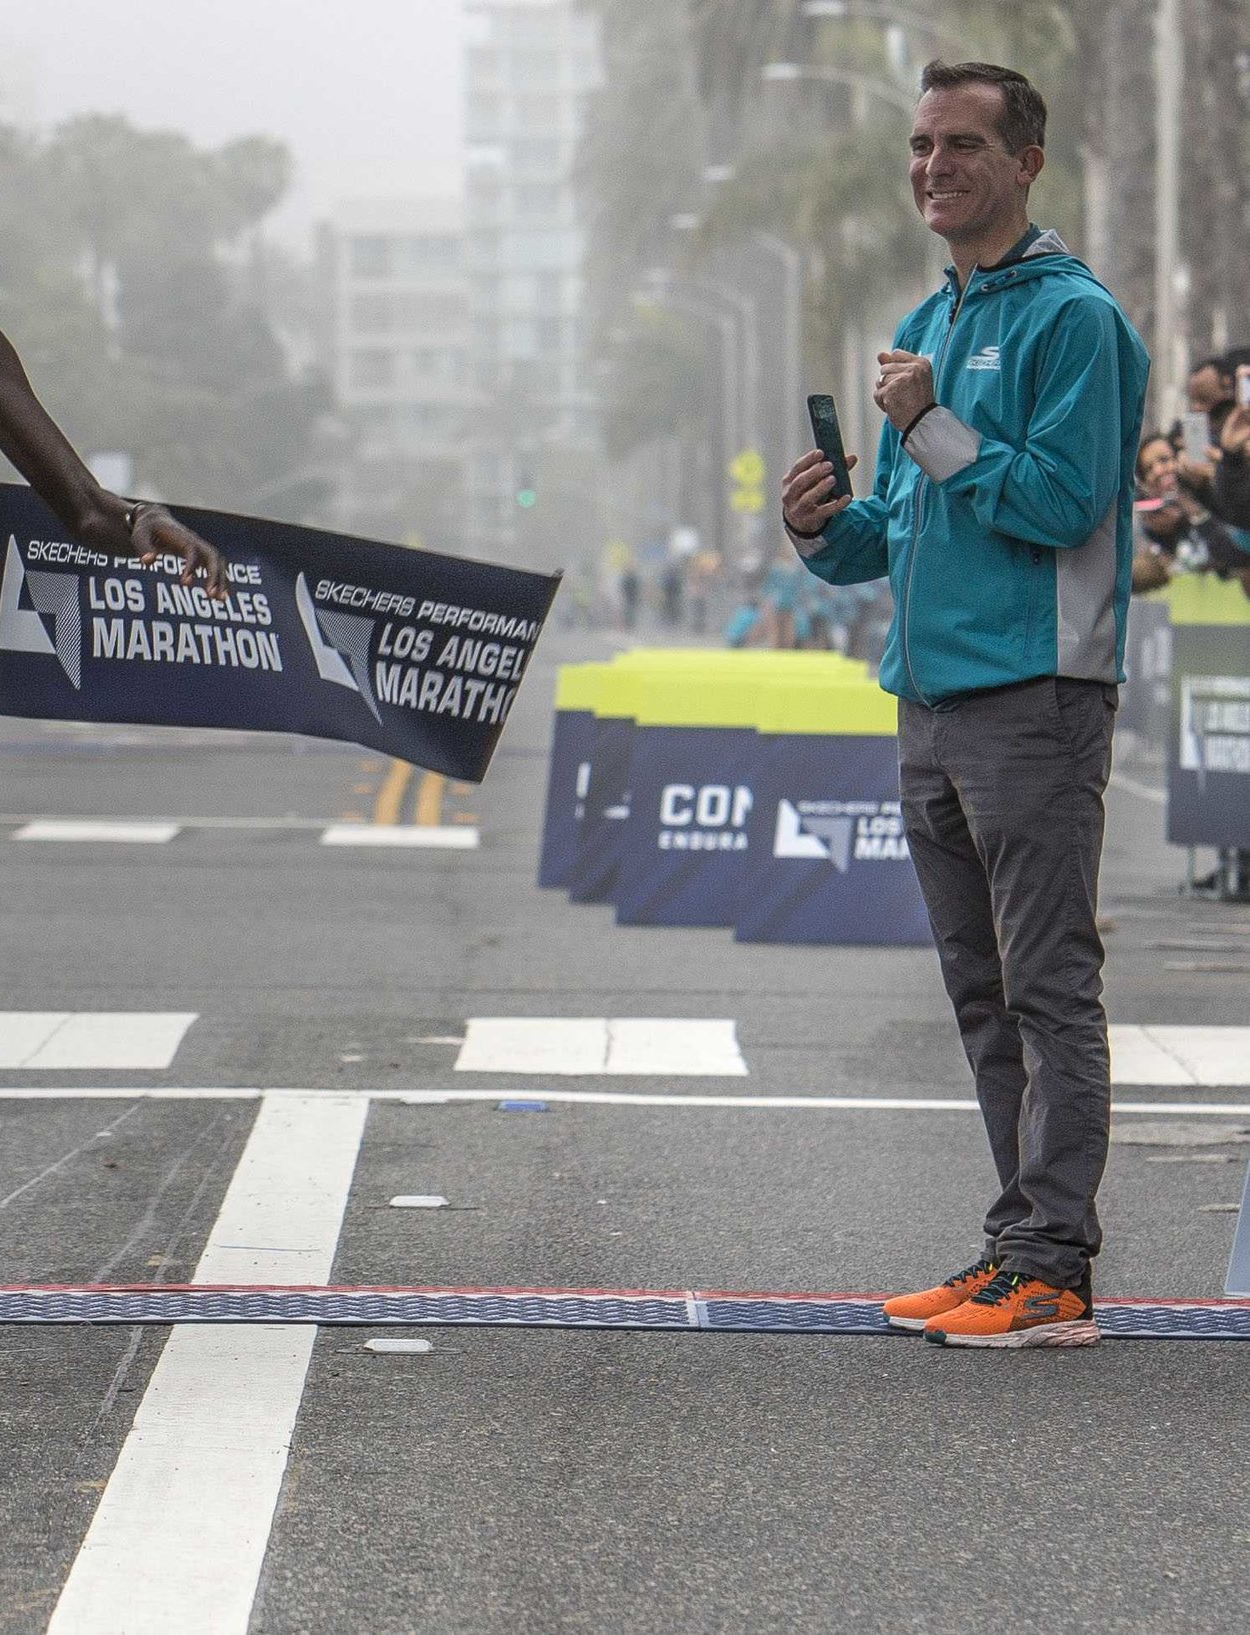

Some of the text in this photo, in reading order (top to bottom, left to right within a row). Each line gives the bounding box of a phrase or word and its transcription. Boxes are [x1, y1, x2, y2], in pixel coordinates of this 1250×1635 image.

[89, 576, 145, 612] LOS
[315, 580, 414, 617] SKECHERS
[92, 617, 283, 672] MARATHON
[378, 622, 432, 662] LOS
